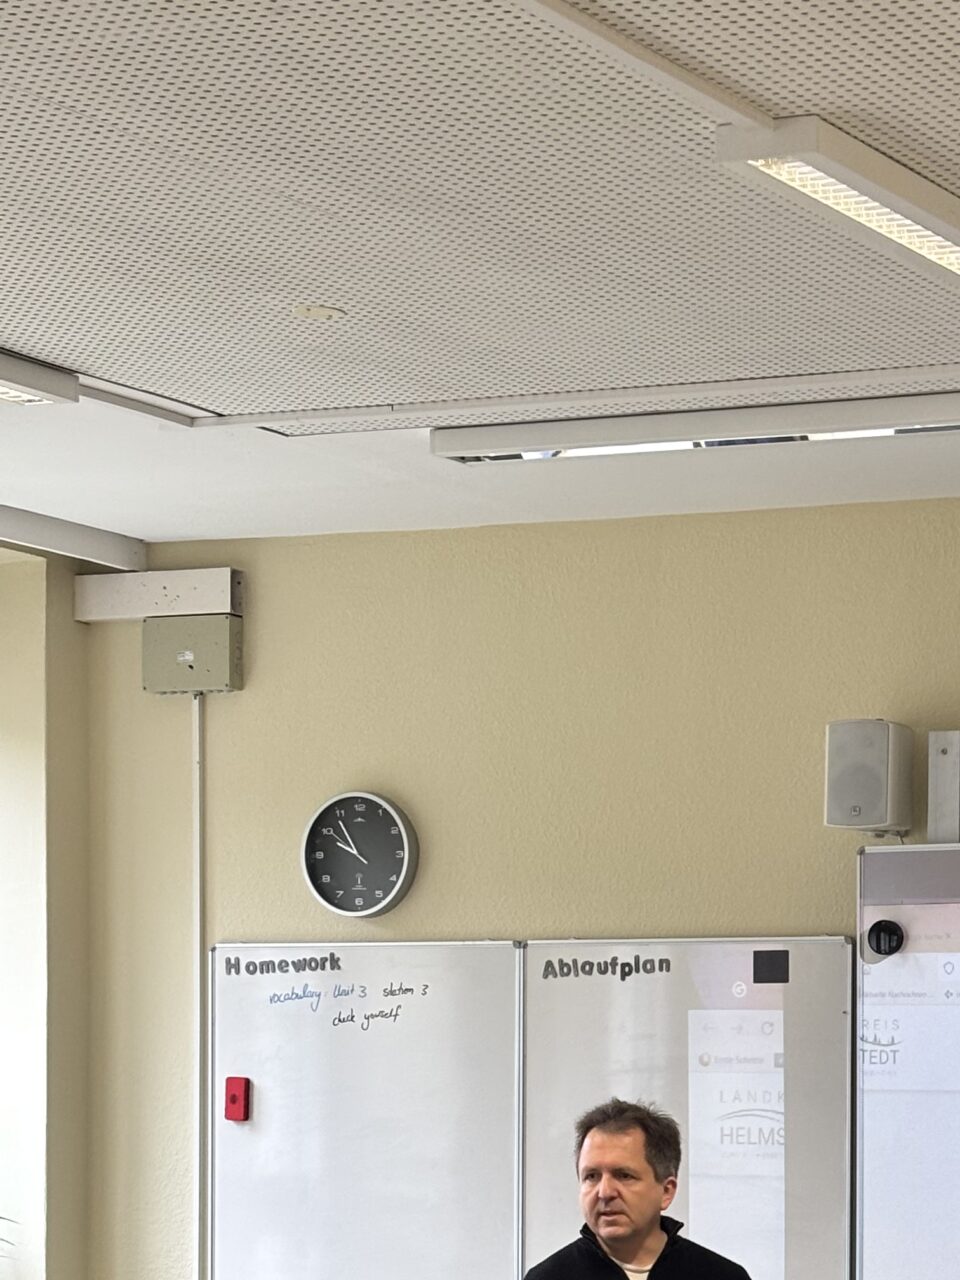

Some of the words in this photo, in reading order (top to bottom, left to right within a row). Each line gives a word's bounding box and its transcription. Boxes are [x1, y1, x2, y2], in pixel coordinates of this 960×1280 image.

[354, 804, 366, 812] 12
[335, 809, 345, 817] 11
[321, 827, 333, 835] 10
[391, 826, 399, 834] 2
[315, 851, 324, 859] 9
[322, 875, 331, 883] 8
[389, 874, 397, 882] 4
[336, 890, 344, 898] 7
[375, 890, 384, 898] 5
[224, 952, 342, 976] Homework
[541, 954, 671, 982] Ablaufplan
[332, 983, 355, 999] Unit
[358, 985, 368, 998] 3
[421, 983, 429, 996] 3
[360, 1004, 402, 1031] yourself
